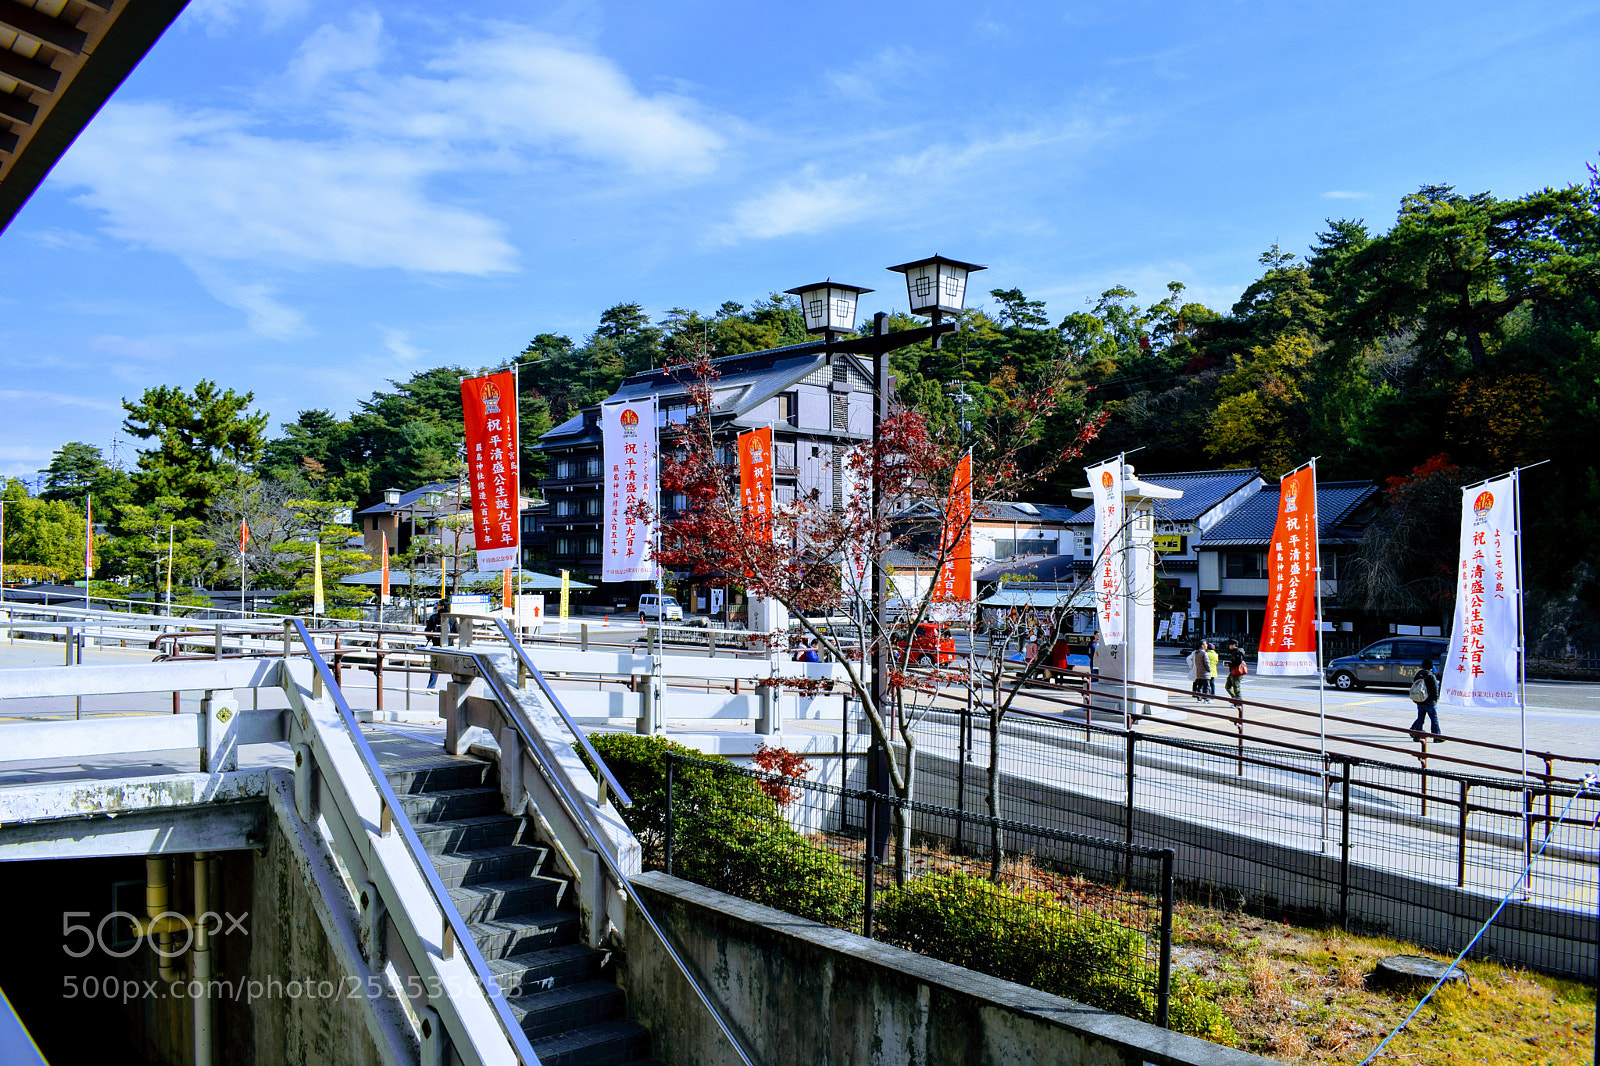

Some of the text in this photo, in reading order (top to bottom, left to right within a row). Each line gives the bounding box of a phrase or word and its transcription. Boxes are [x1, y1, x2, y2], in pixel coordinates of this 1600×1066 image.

[1494, 528, 1505, 599] ようこそ宮島へ
